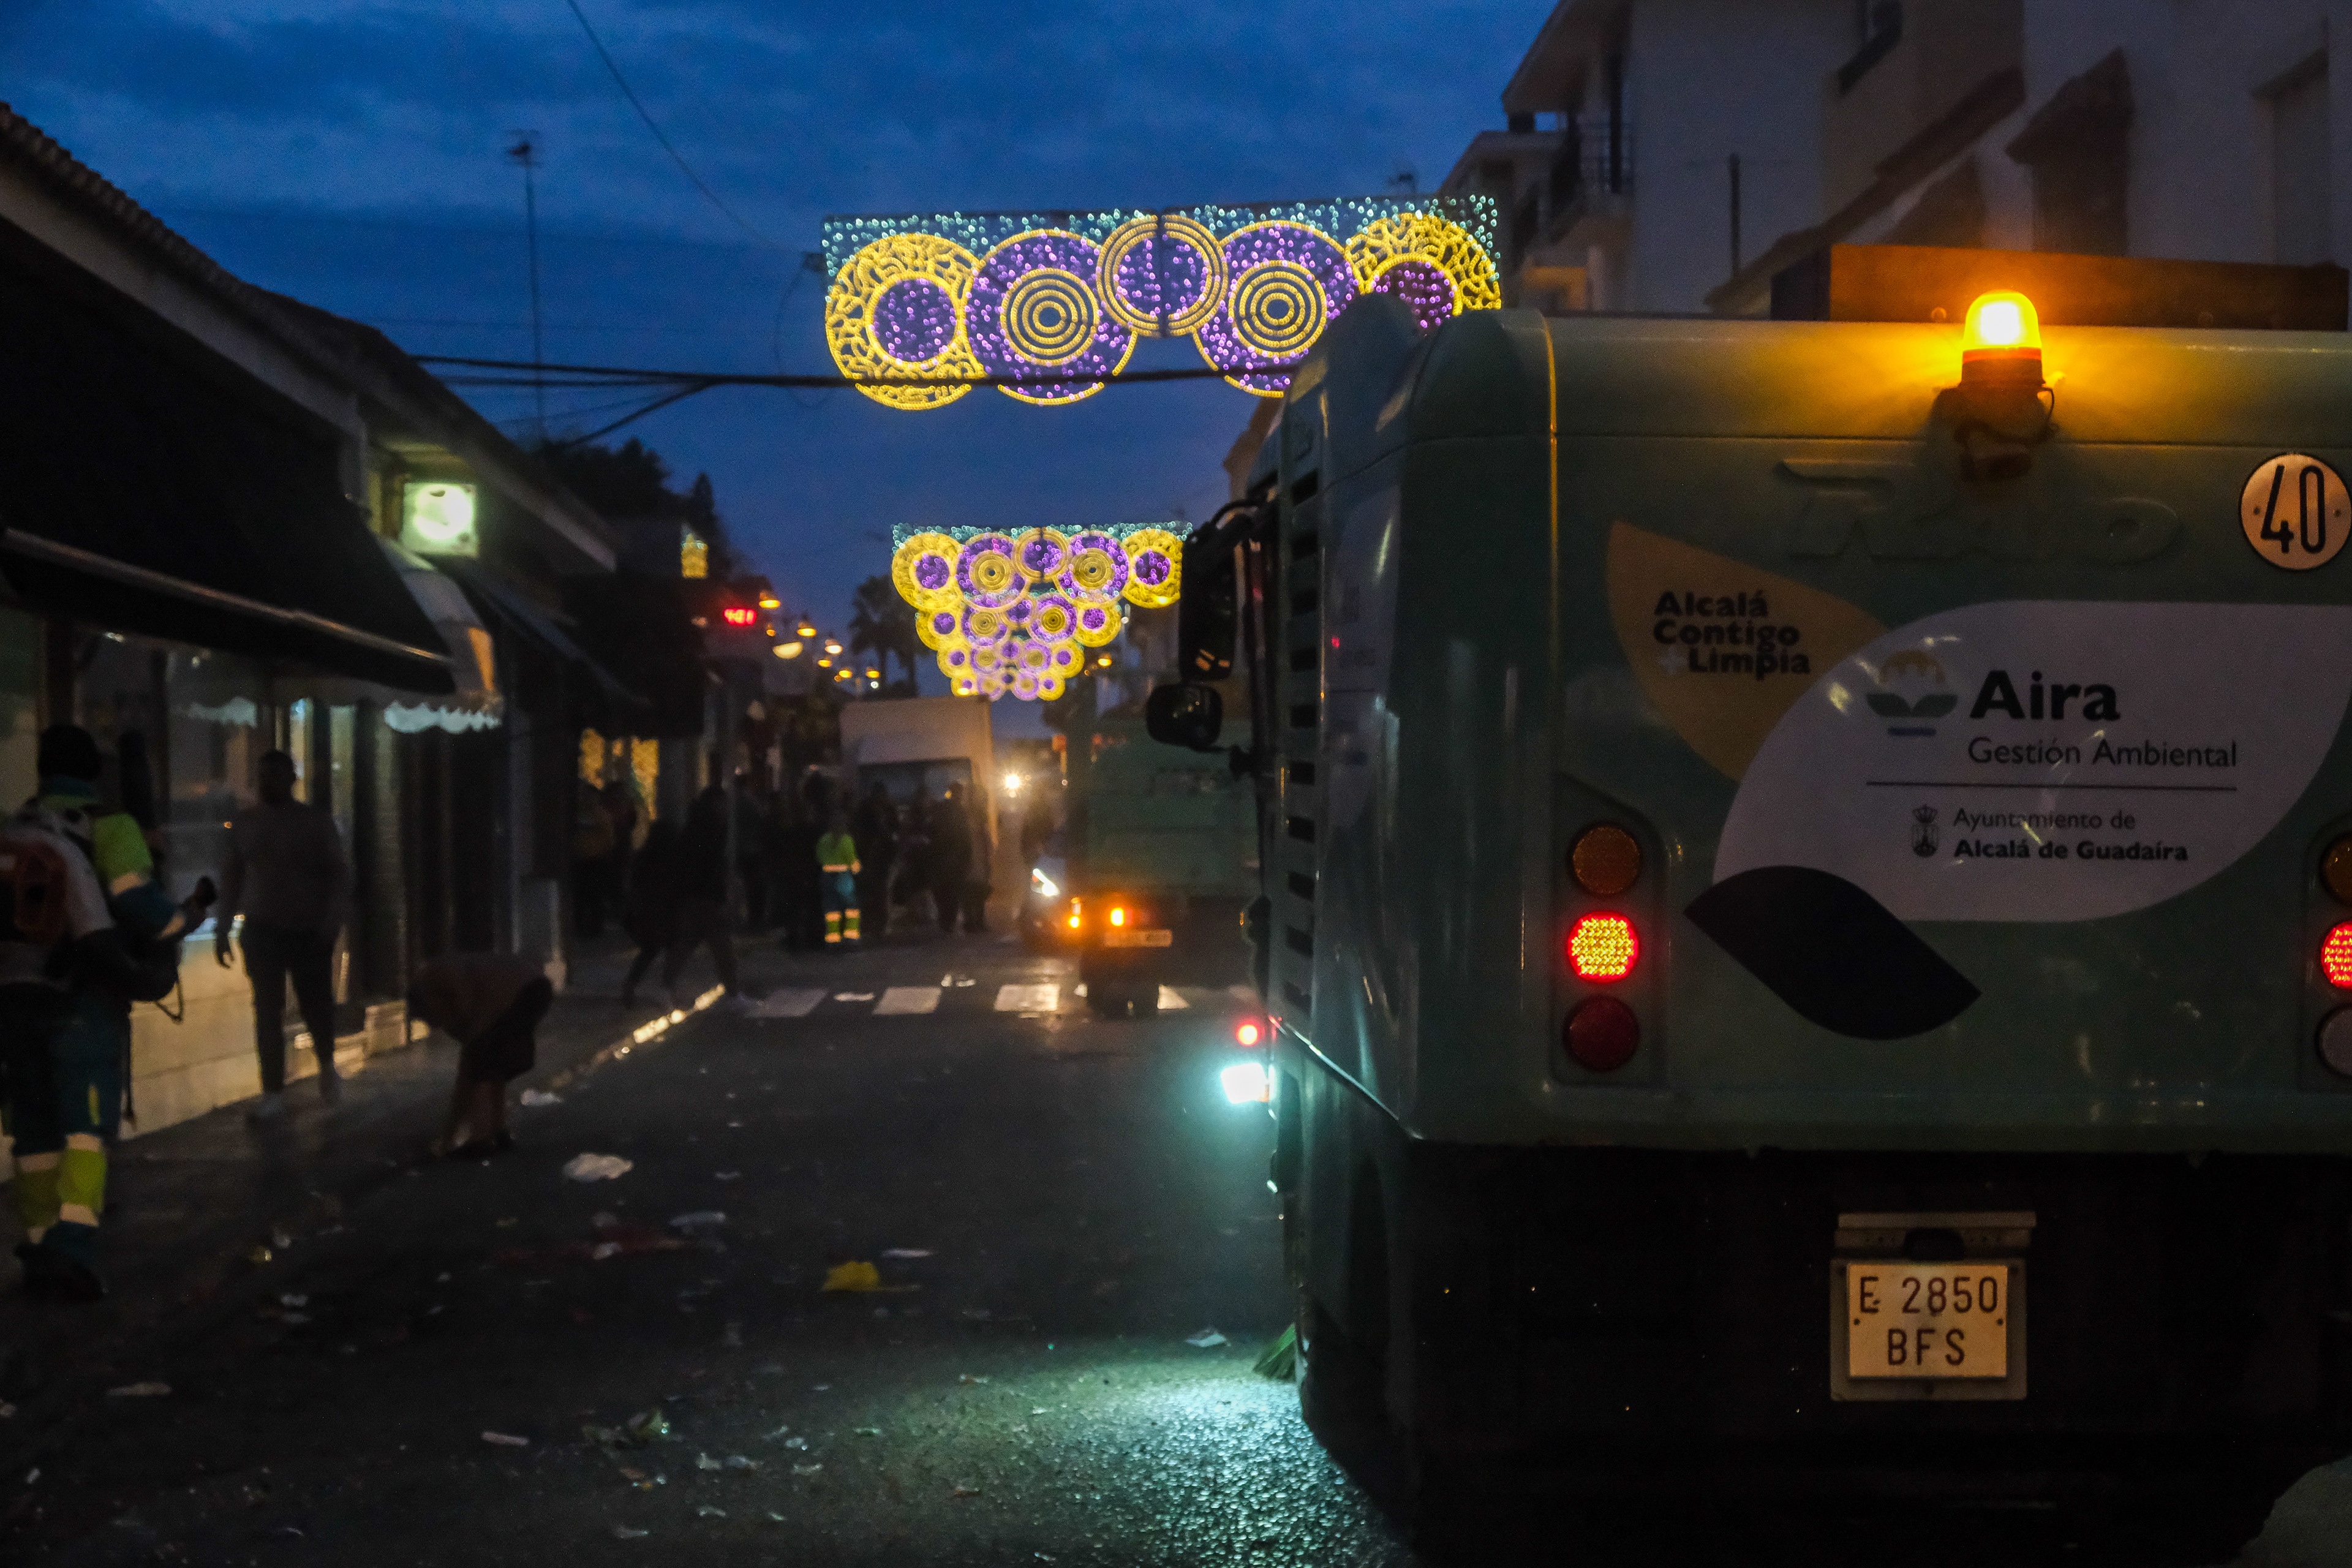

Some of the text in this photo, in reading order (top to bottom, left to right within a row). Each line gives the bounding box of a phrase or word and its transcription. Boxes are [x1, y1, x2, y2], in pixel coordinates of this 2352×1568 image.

[2260, 464, 2326, 554] 40
[1654, 590, 1768, 617] Alcalá
[1653, 619, 1801, 653] Contigo
[1688, 647, 1811, 681] Limpia
[1969, 670, 2121, 722] Aira
[1968, 737, 2237, 767] Gestión Ambiental
[1953, 807, 2136, 832] Ayuntamiento de
[1954, 839, 2188, 861] Alcalá de Guadaíra
[1860, 1276, 1998, 1314] E 2850
[1887, 1328, 1966, 1366] BFS
